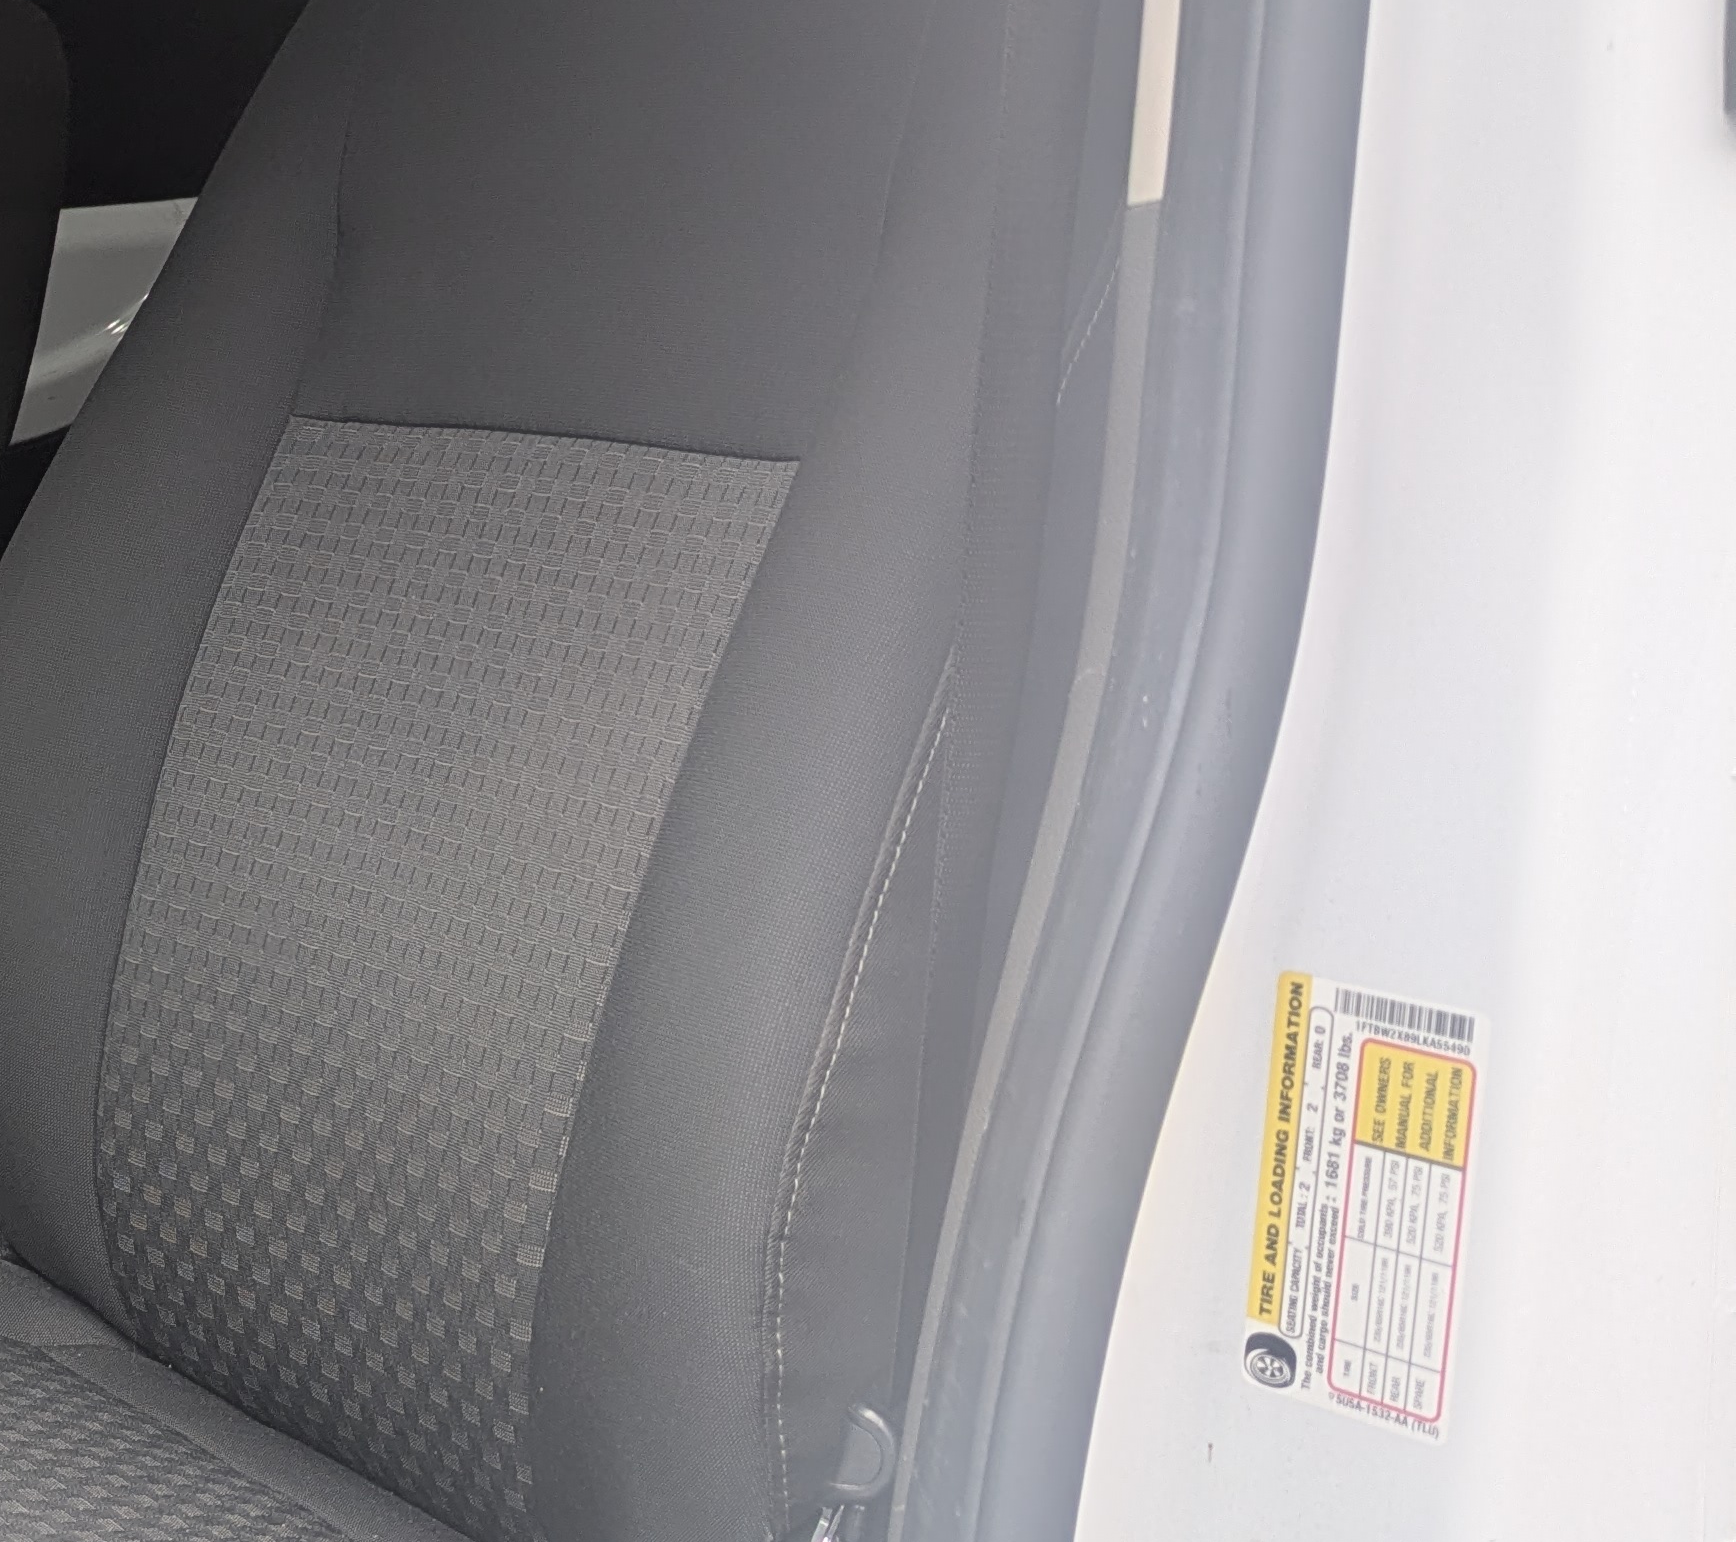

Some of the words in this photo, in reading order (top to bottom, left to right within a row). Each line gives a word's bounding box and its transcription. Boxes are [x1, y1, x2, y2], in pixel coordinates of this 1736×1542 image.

[1277, 980, 1303, 1123] INFORMATION
[1333, 1060, 1349, 1102] 3708
[1374, 1056, 1391, 1114] OWNERS
[1400, 1060, 1414, 1089] FOR
[1333, 1107, 1345, 1123] or
[1371, 1117, 1385, 1143] SEE
[1394, 1091, 1411, 1149] MANUAL
[1418, 1070, 1438, 1152] ADDITIONAL
[1441, 1066, 1463, 1161] INFORMATION
[1328, 1125, 1345, 1147] kg
[1268, 1128, 1289, 1218] LOADING
[1324, 1150, 1340, 1190] 1681
[1263, 1222, 1280, 1266] AND
[1315, 1202, 1331, 1259] occupants
[1326, 1205, 1339, 1245] exceed
[1289, 1246, 1303, 1292] CAPACITY
[1314, 1261, 1323, 1272] of
[1324, 1248, 1335, 1278] never
[1259, 1270, 1275, 1317] TIRE
[1285, 1294, 1298, 1333] SEATING
[1309, 1275, 1323, 1312] weight
[1319, 1280, 1332, 1317] should
[1303, 1314, 1317, 1367] combined
[1316, 1318, 1330, 1351] cargo
[1300, 1369, 1311, 1389] The
[1314, 1353, 1325, 1374] and
